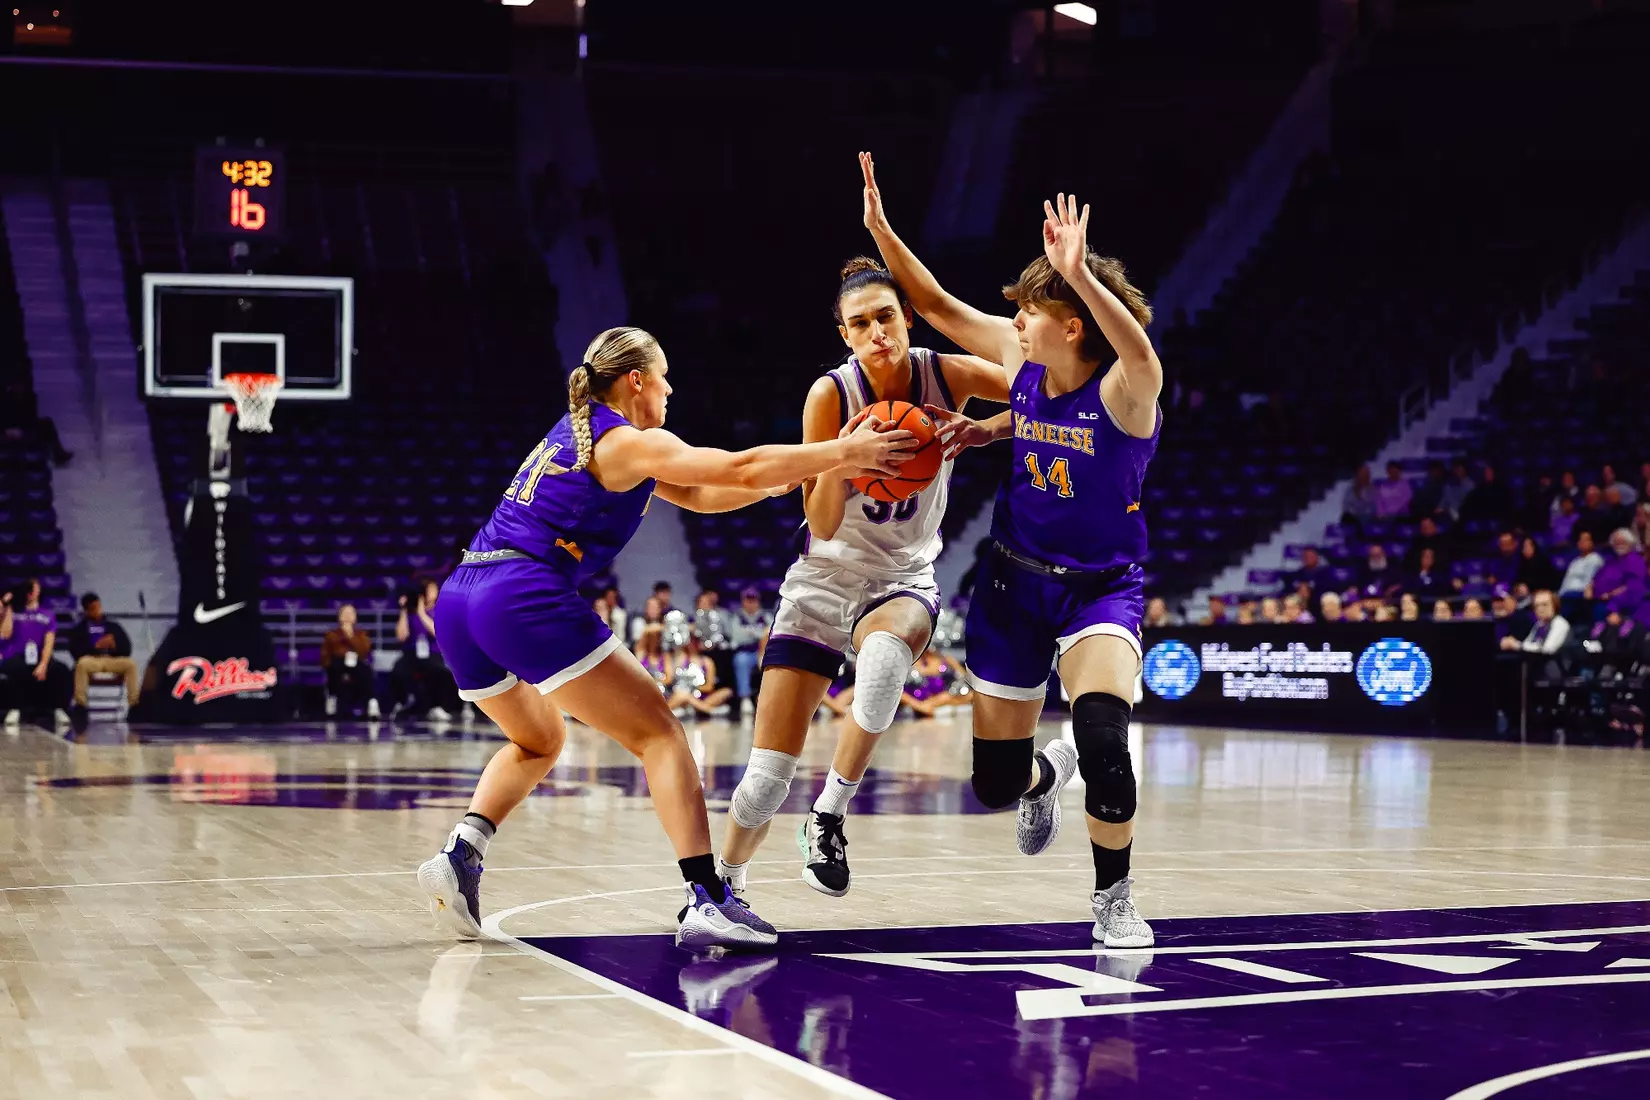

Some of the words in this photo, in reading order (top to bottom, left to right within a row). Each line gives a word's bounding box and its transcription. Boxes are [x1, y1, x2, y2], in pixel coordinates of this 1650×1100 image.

[222, 160, 272, 187] 4:32
[231, 188, 266, 230] 16
[503, 437, 564, 506] 21
[1024, 451, 1074, 498] 14
